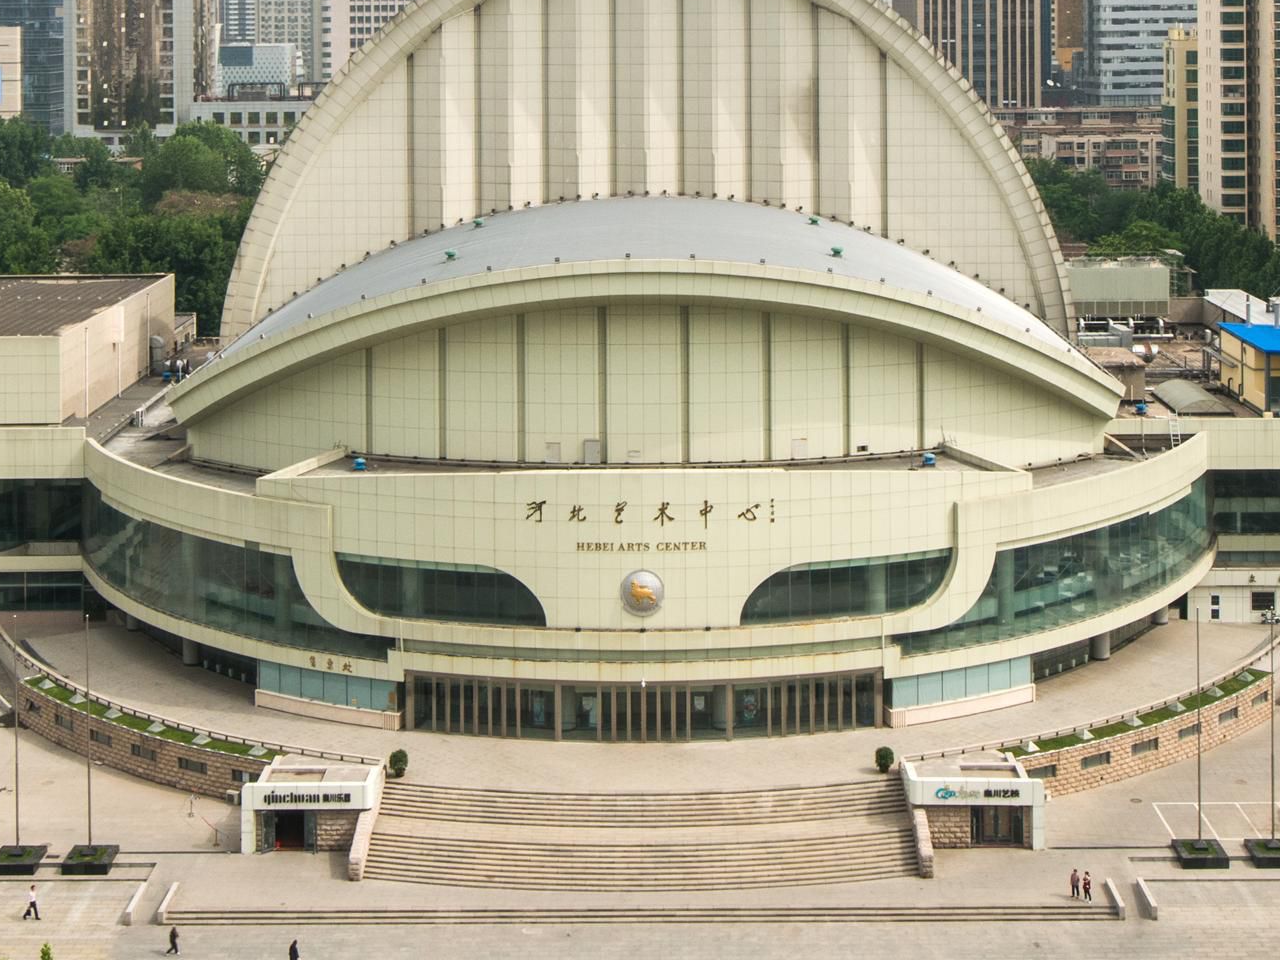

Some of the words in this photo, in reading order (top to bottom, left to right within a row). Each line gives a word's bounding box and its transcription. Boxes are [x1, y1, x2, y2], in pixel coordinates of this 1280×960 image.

[526, 499, 762, 530] 河北艺术中心
[576, 542, 615, 552] HEBEI
[619, 542, 650, 552] ARTS
[656, 541, 707, 551] CENTER
